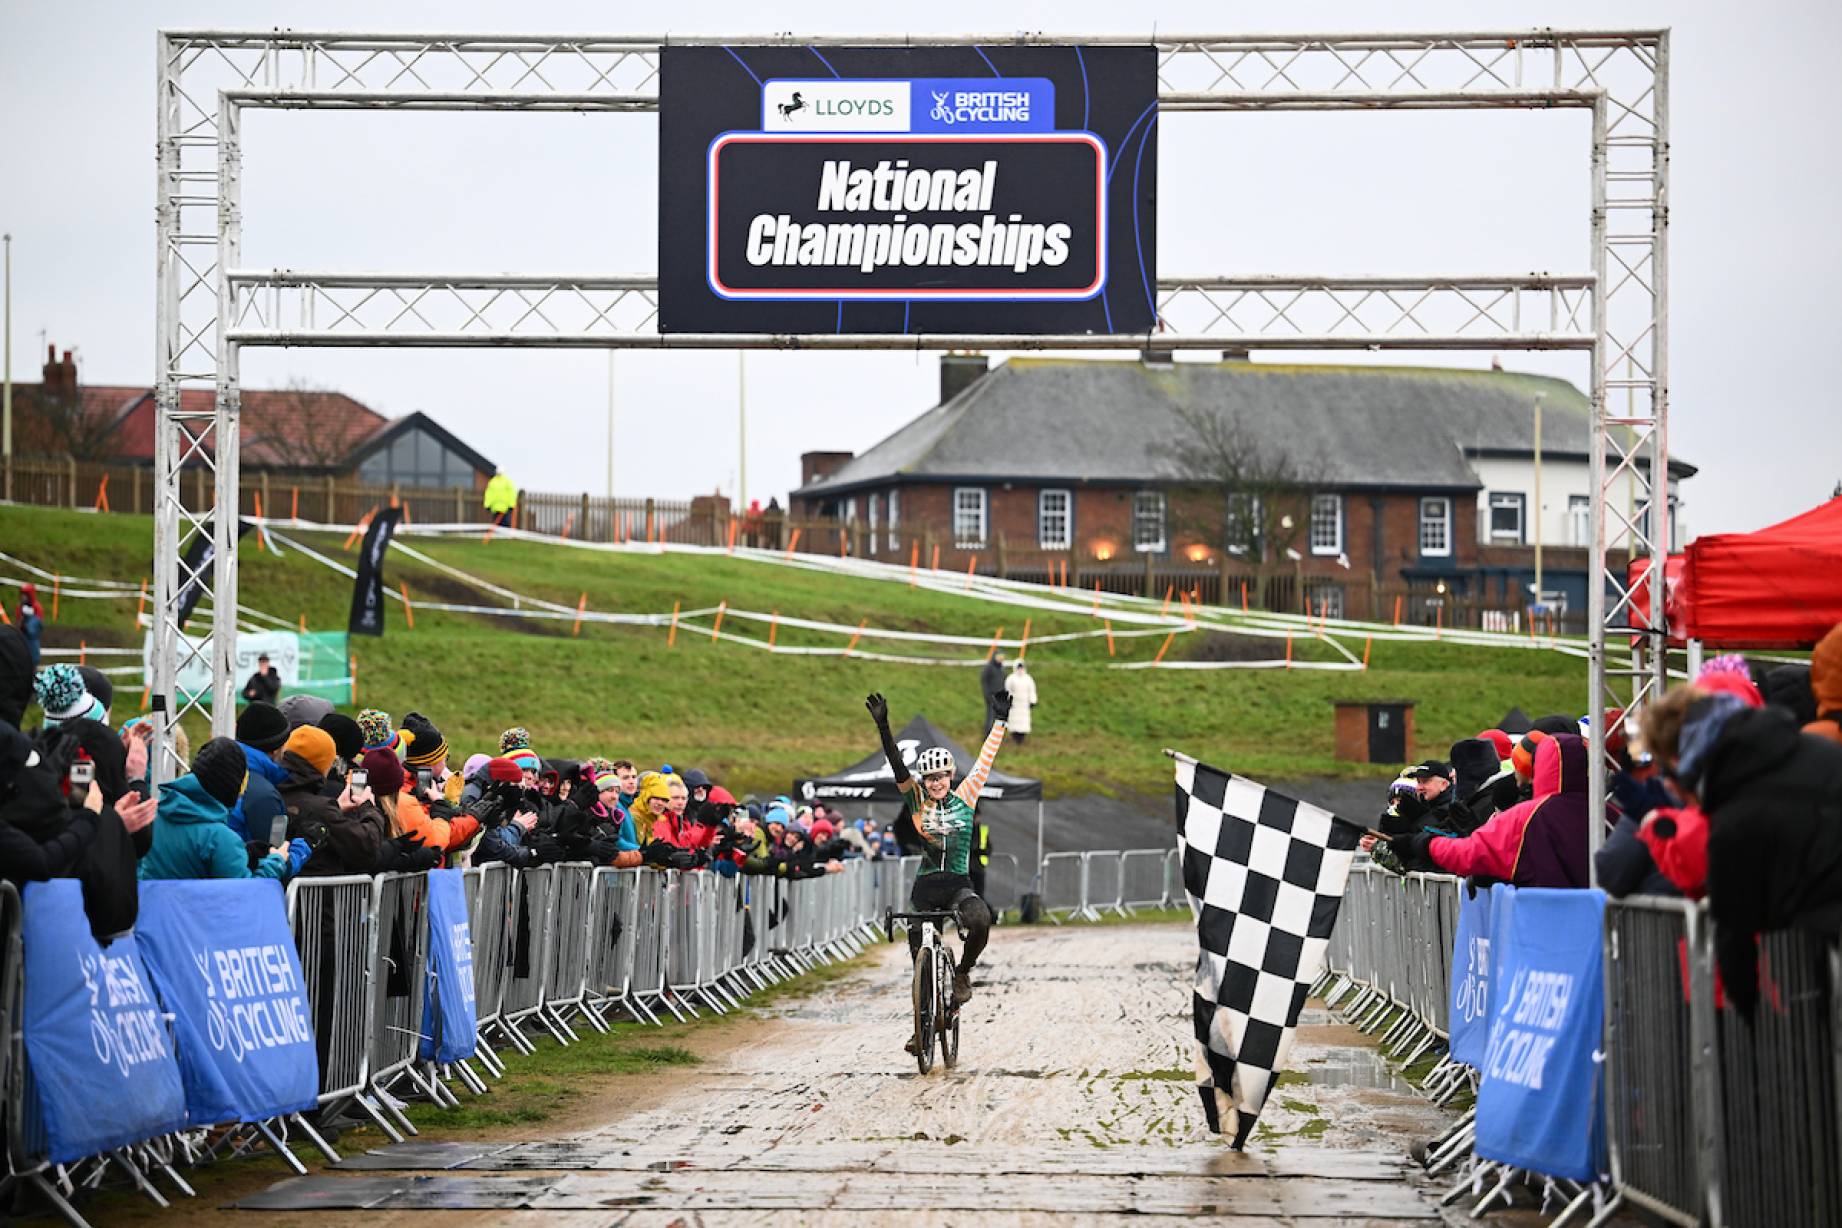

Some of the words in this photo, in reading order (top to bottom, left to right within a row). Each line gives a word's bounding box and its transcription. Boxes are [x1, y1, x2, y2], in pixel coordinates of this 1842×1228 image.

[815, 99, 894, 116] LLOYDS
[954, 91, 1030, 107] BRITISH
[954, 106, 1030, 123] CYCLING
[816, 160, 998, 213] National
[745, 213, 1072, 274] Championships
[213, 944, 297, 999] BRITISH
[232, 996, 310, 1051] CYCLING
